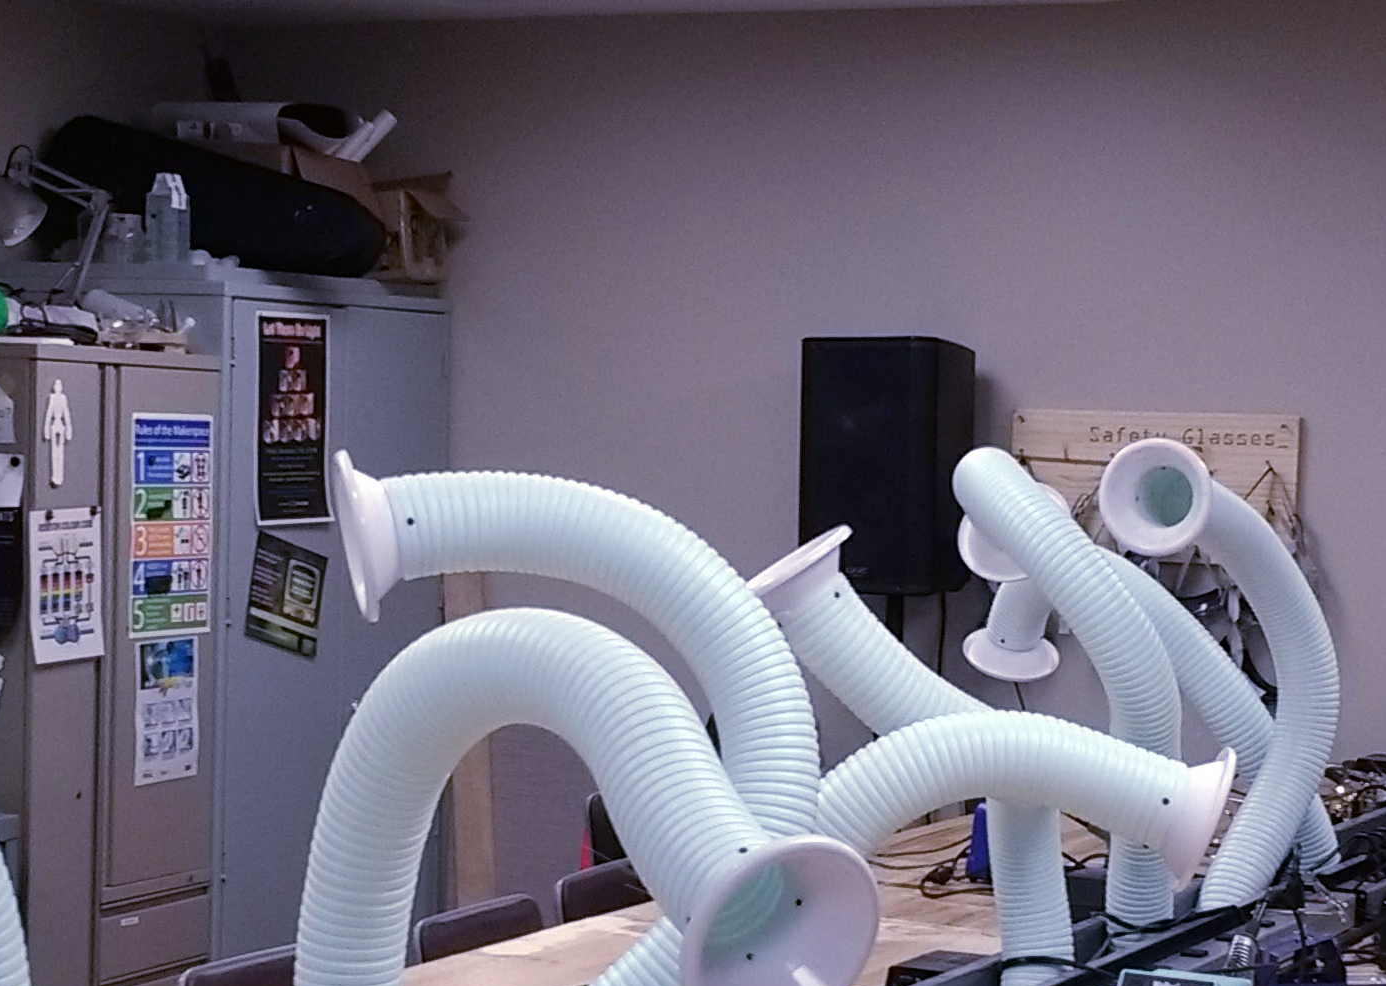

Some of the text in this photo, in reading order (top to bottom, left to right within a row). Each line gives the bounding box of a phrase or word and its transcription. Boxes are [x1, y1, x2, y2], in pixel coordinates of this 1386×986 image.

[137, 452, 145, 481] 1
[135, 488, 147, 518] 2
[135, 525, 147, 556] 3
[133, 562, 146, 592] 4
[133, 599, 145, 630] 5
